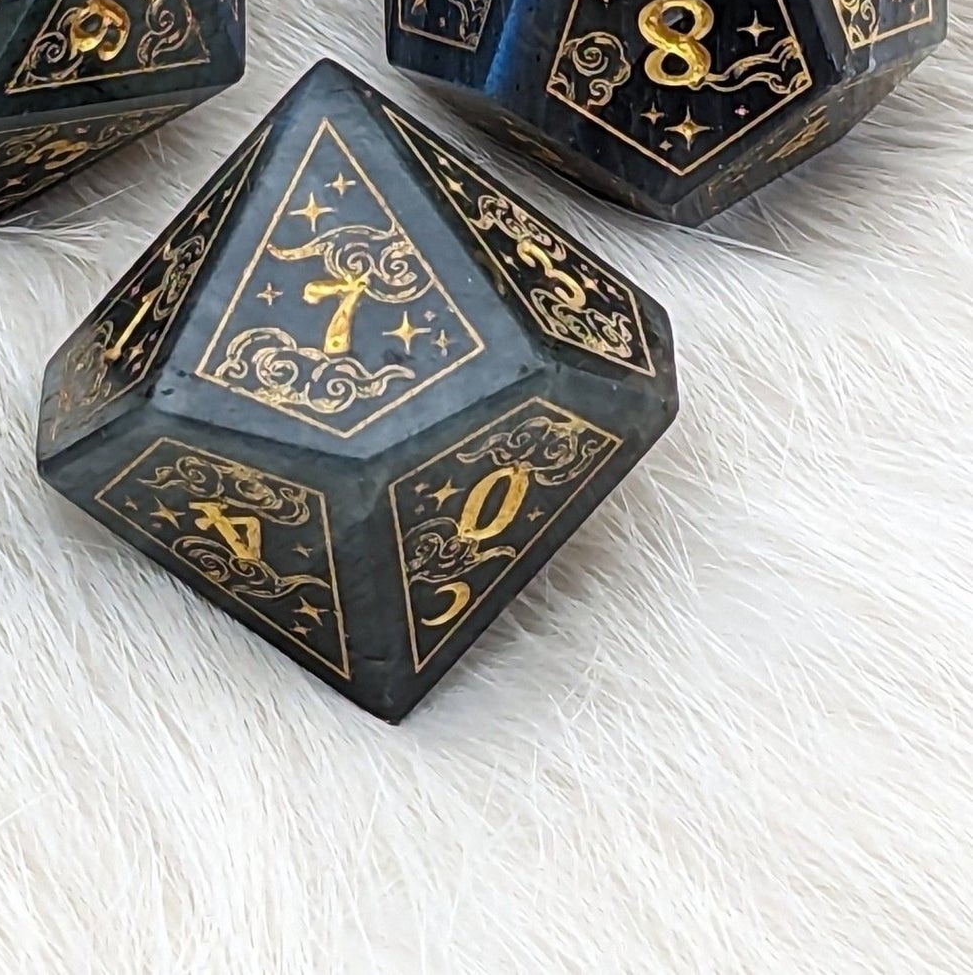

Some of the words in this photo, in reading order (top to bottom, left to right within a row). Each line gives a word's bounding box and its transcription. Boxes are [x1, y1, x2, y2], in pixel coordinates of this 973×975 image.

[517, 239, 587, 311] 3
[303, 278, 371, 354] 7
[188, 501, 261, 562] 4
[457, 463, 530, 542] 0
